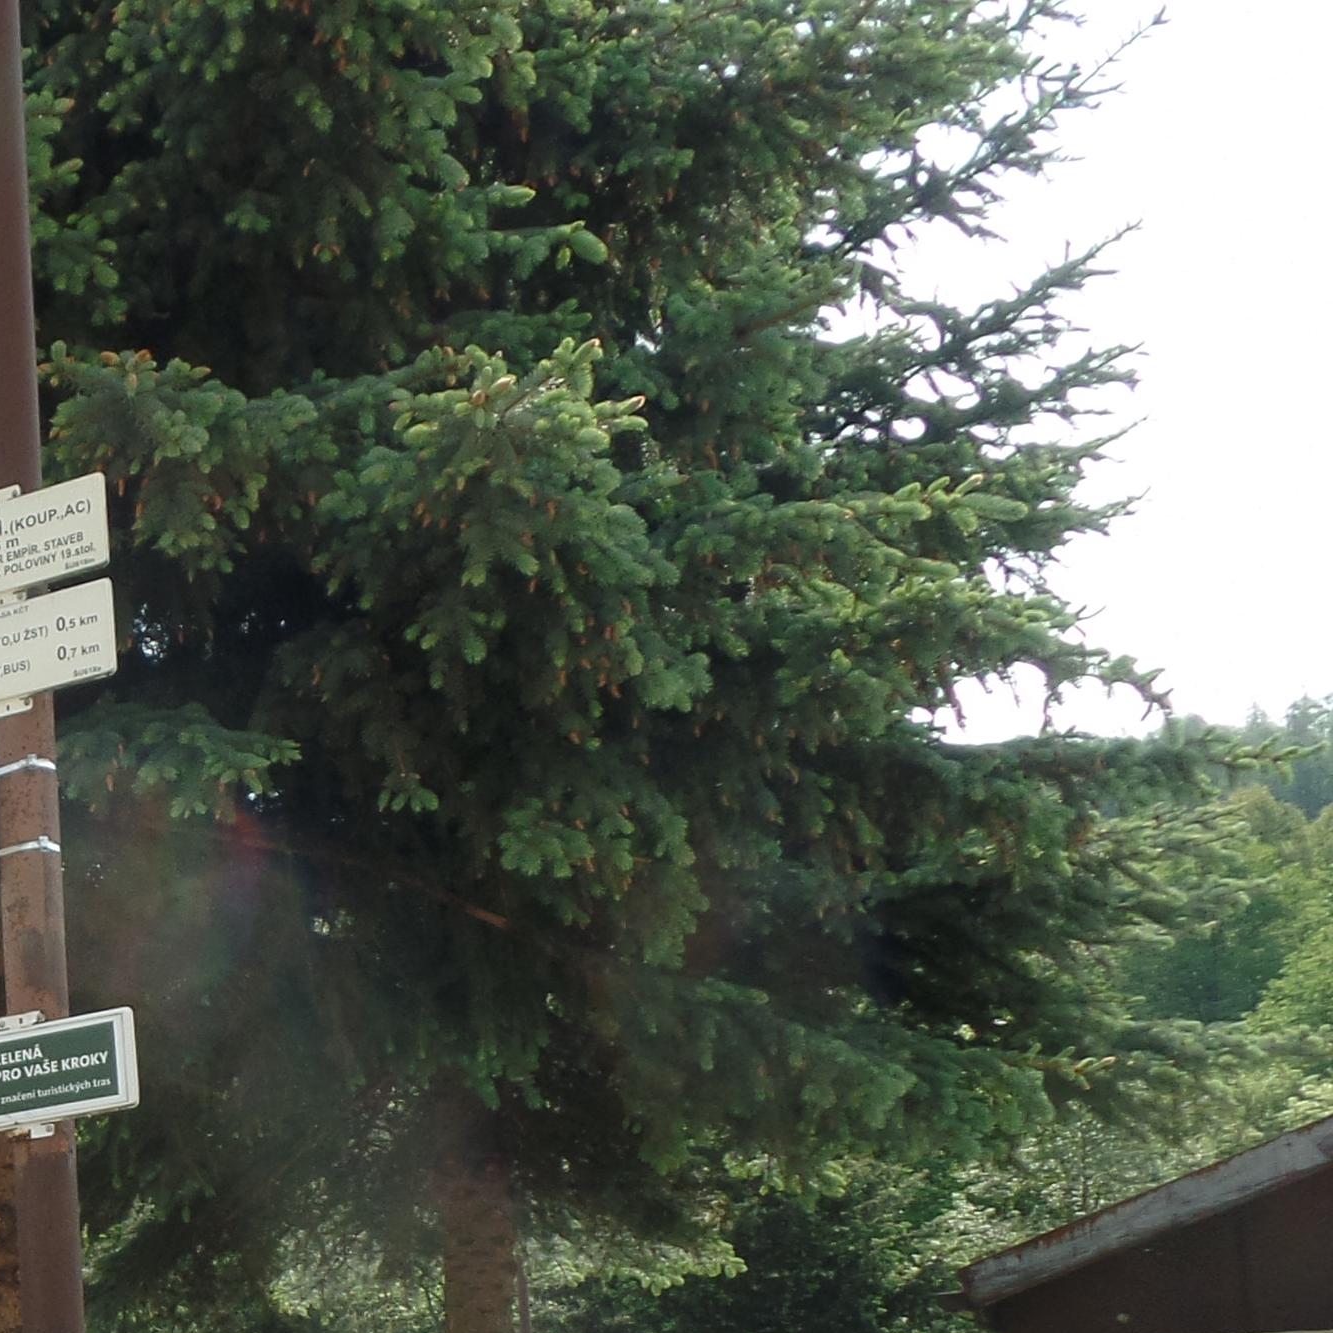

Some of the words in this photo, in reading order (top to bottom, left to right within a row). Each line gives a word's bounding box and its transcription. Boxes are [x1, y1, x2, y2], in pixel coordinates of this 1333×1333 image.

[6, 538, 19, 549] m
[44, 531, 84, 551] STAVEB
[4, 553, 56, 575] POLOVINY
[13, 605, 29, 614] KČT
[23, 625, 48, 641] ŽST)
[56, 616, 76, 632] 0,5
[79, 614, 98, 626] km
[57, 645, 77, 660] 0,7
[81, 643, 99, 655] km
[23, 1059, 59, 1077] VAŠE
[61, 1050, 108, 1071] KROKY
[0, 1089, 36, 1105] značení
[37, 1079, 91, 1097] turistických
[93, 1077, 111, 1088] tras
